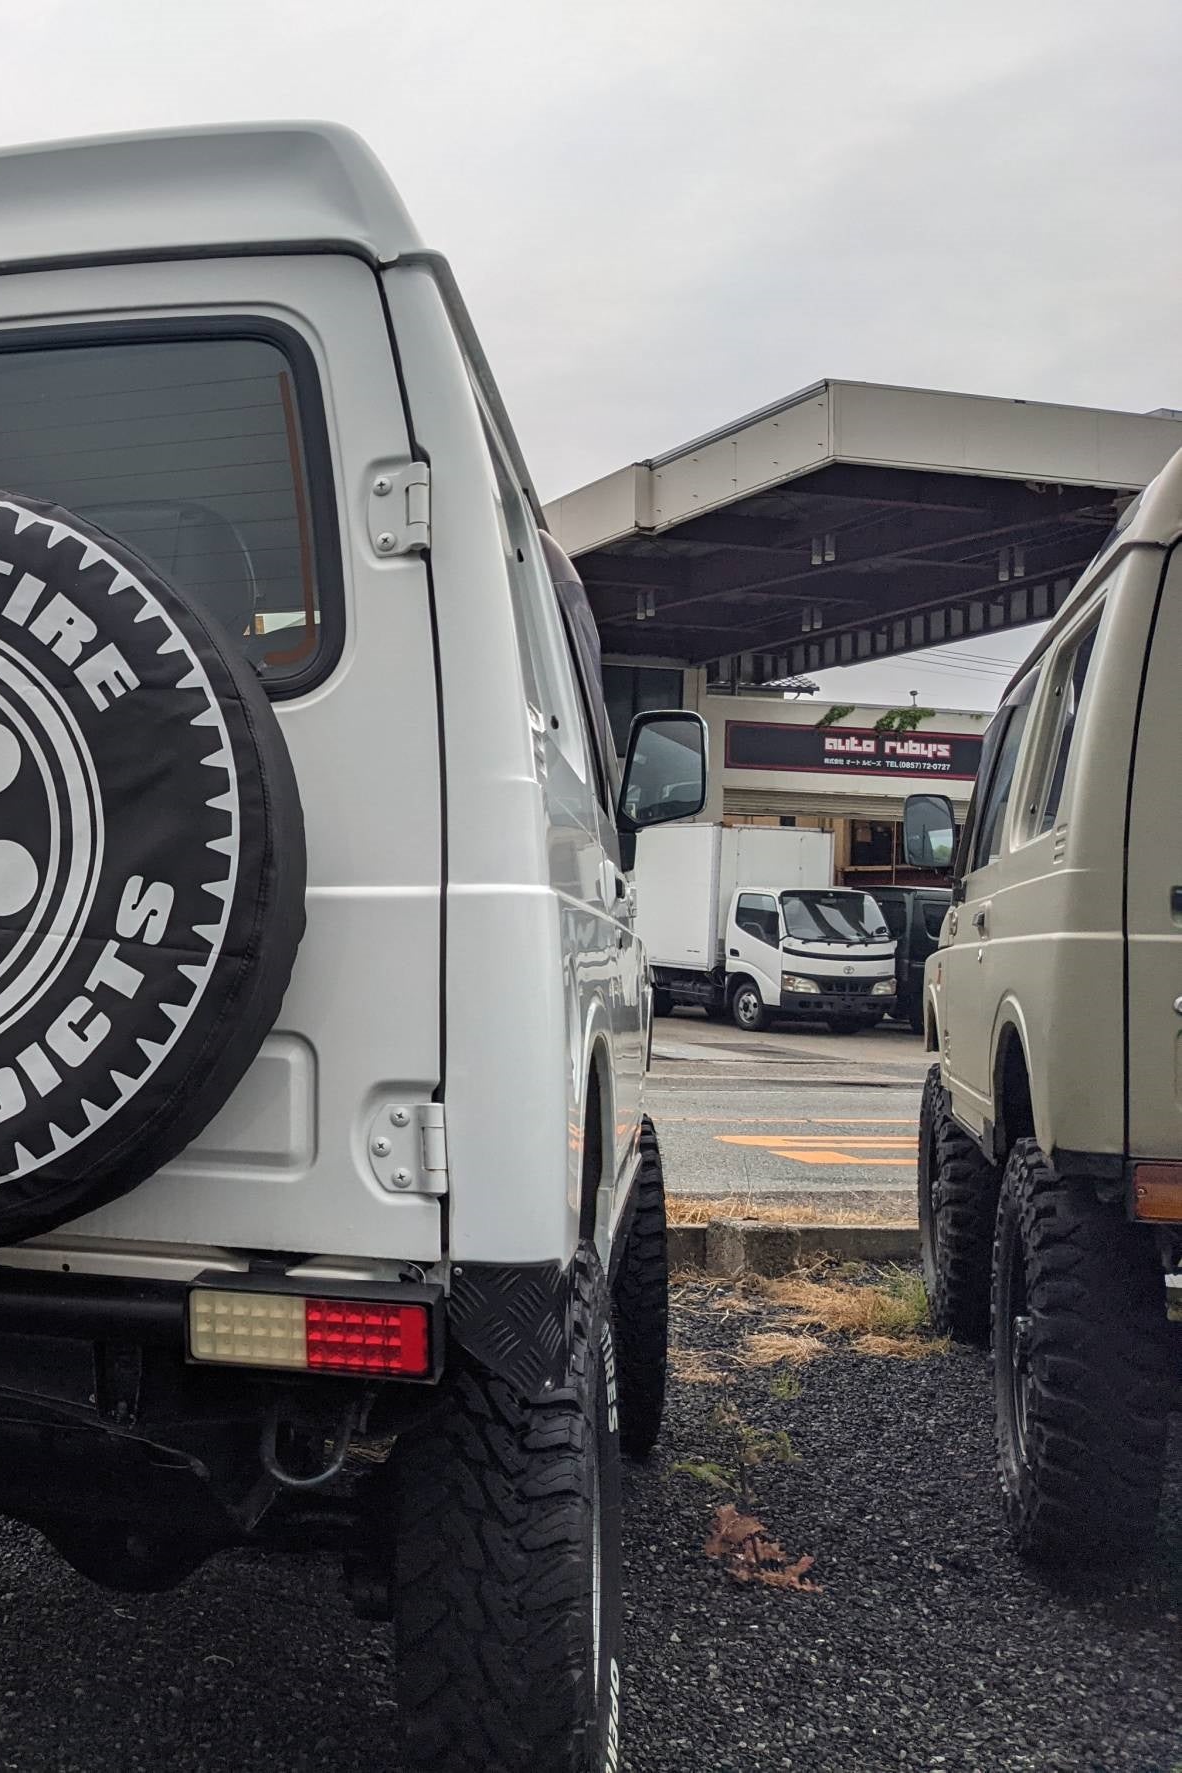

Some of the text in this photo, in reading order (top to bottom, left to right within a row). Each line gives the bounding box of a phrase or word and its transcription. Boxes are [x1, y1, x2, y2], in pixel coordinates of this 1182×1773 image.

[824, 736, 876, 752] auto
[602, 1332, 618, 1433] TIRES
[607, 1657, 619, 1772] OPEN
